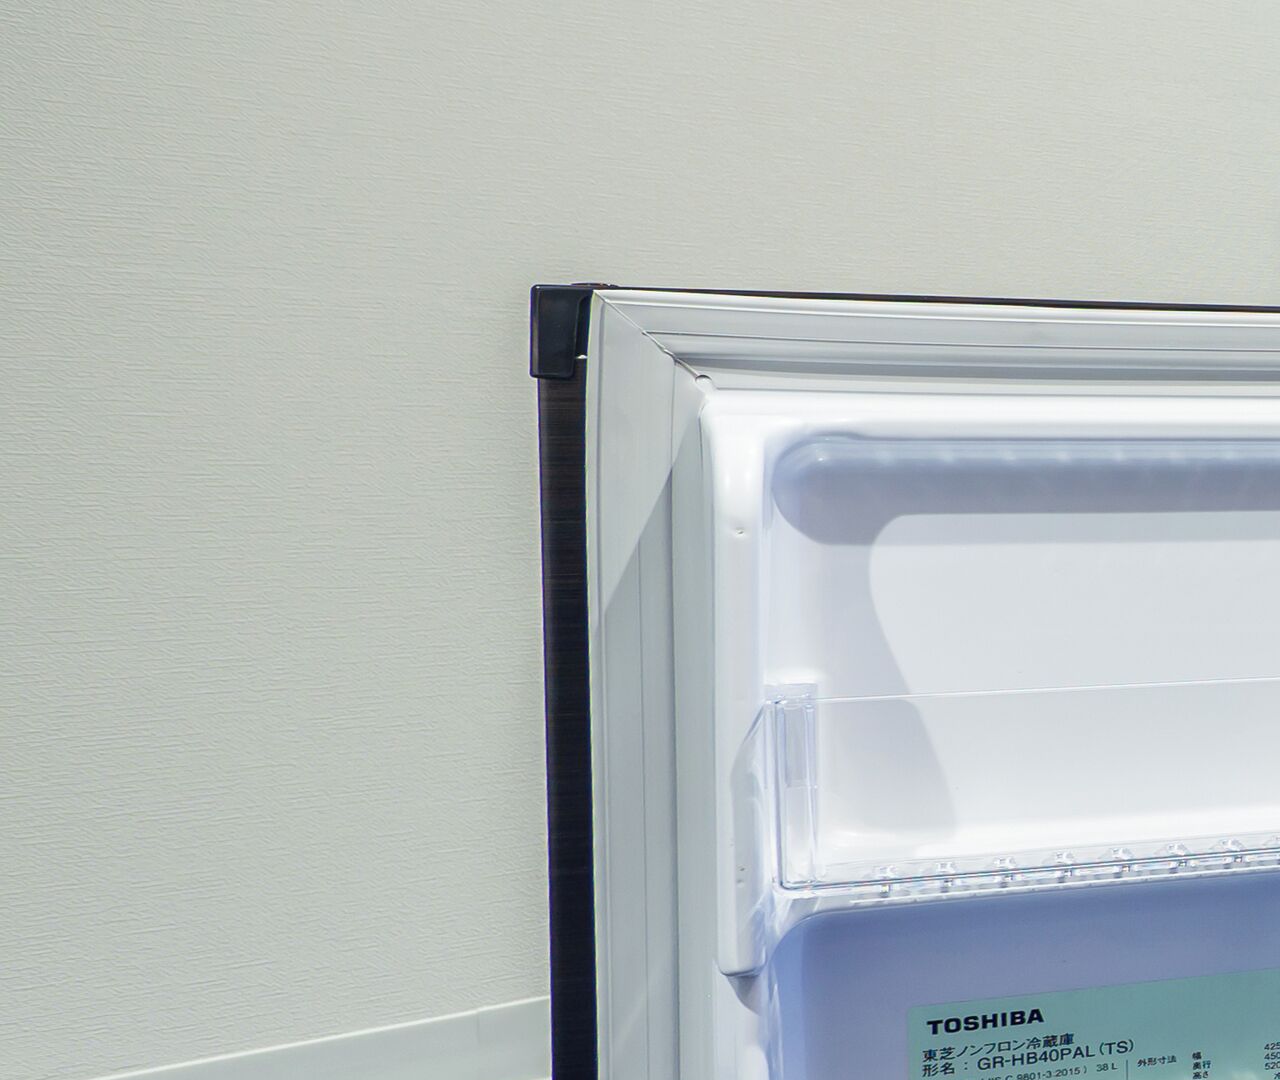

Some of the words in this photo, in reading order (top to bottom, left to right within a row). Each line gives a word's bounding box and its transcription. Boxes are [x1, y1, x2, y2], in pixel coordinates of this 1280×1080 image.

[926, 1007, 1044, 1036] TOSHIBA
[922, 1032, 1075, 1063] 東芝ノンフロン冷蔵庫
[1136, 1053, 1177, 1067] 外形寸法
[1191, 1059, 1211, 1071] 奥行
[1191, 1069, 1209, 1080] 高さ
